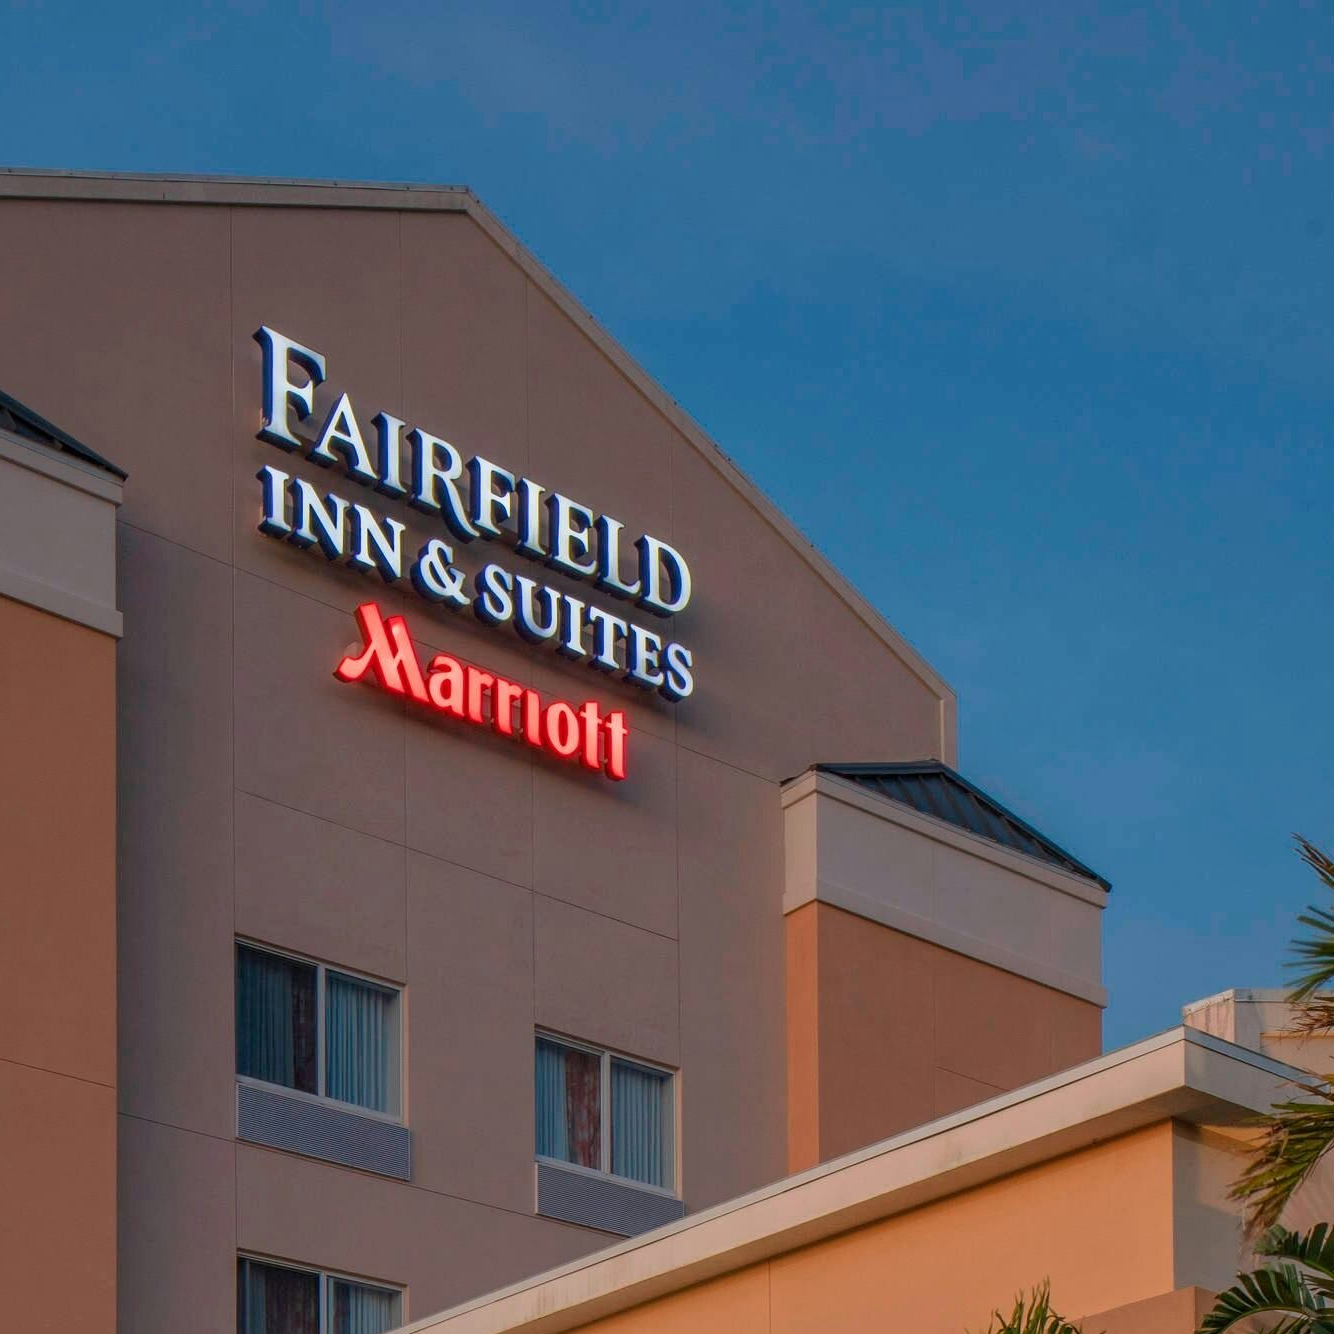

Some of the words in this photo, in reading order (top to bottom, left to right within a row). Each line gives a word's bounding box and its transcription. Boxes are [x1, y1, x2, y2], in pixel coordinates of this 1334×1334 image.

[253, 325, 692, 618] FAIRFIELD
[256, 464, 405, 584] INN
[411, 538, 471, 612] &
[475, 563, 695, 704] SUITES
[332, 602, 628, 782] Marriott
